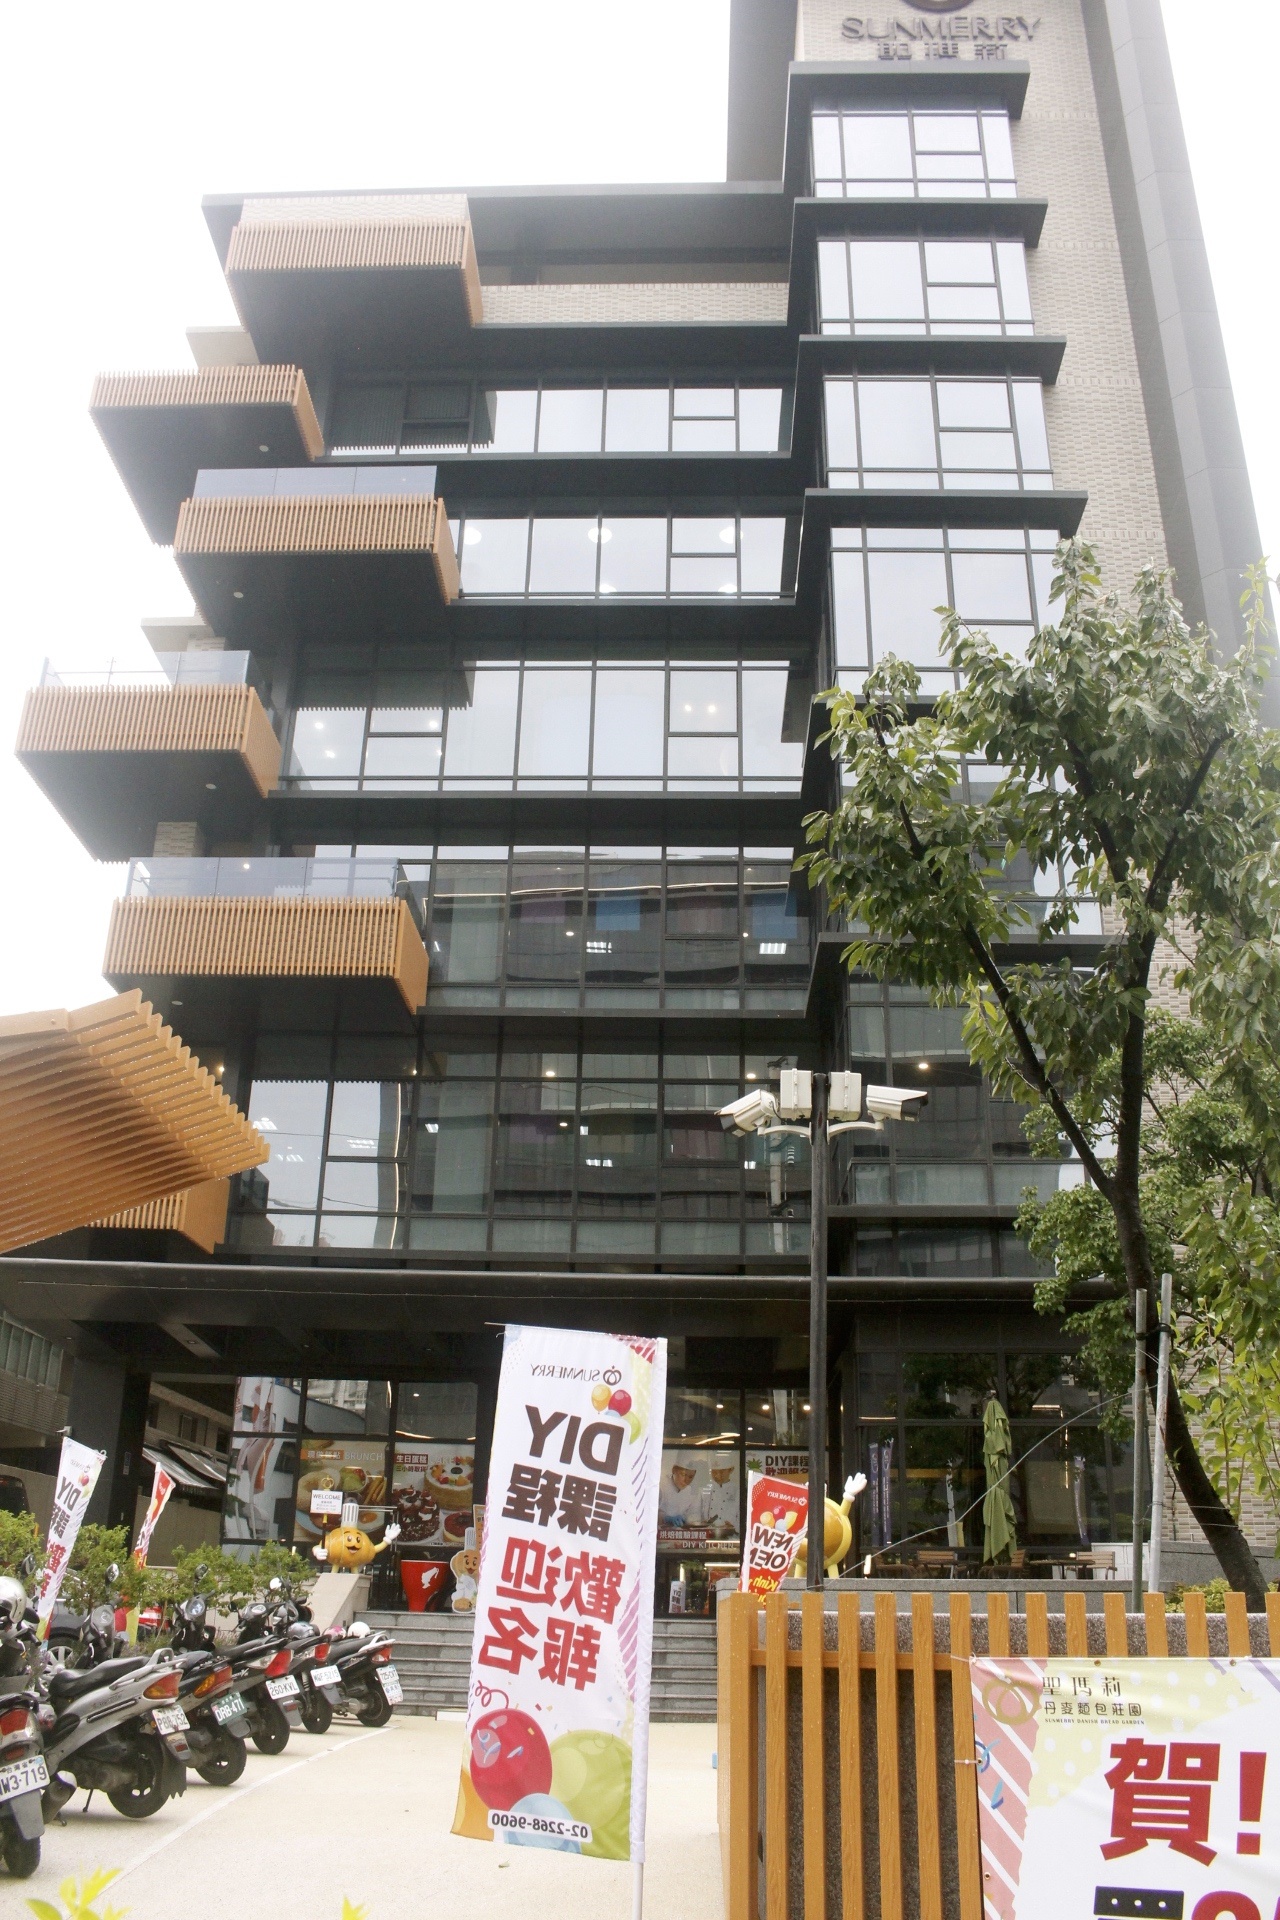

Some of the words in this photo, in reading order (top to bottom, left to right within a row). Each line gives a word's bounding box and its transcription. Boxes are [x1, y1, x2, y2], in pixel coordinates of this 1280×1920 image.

[841, 16, 1041, 41] SUNMERRY
[345, 1452, 383, 1461] BRUNCH
[396, 1455, 427, 1464] 生日蛋糕
[683, 1541, 696, 1549] DIY
[699, 1541, 734, 1549] KITCHEN
[1042, 1676, 1121, 1697] 聖瑪莉
[1044, 1701, 1142, 1716] 丹麥麵包莊園
